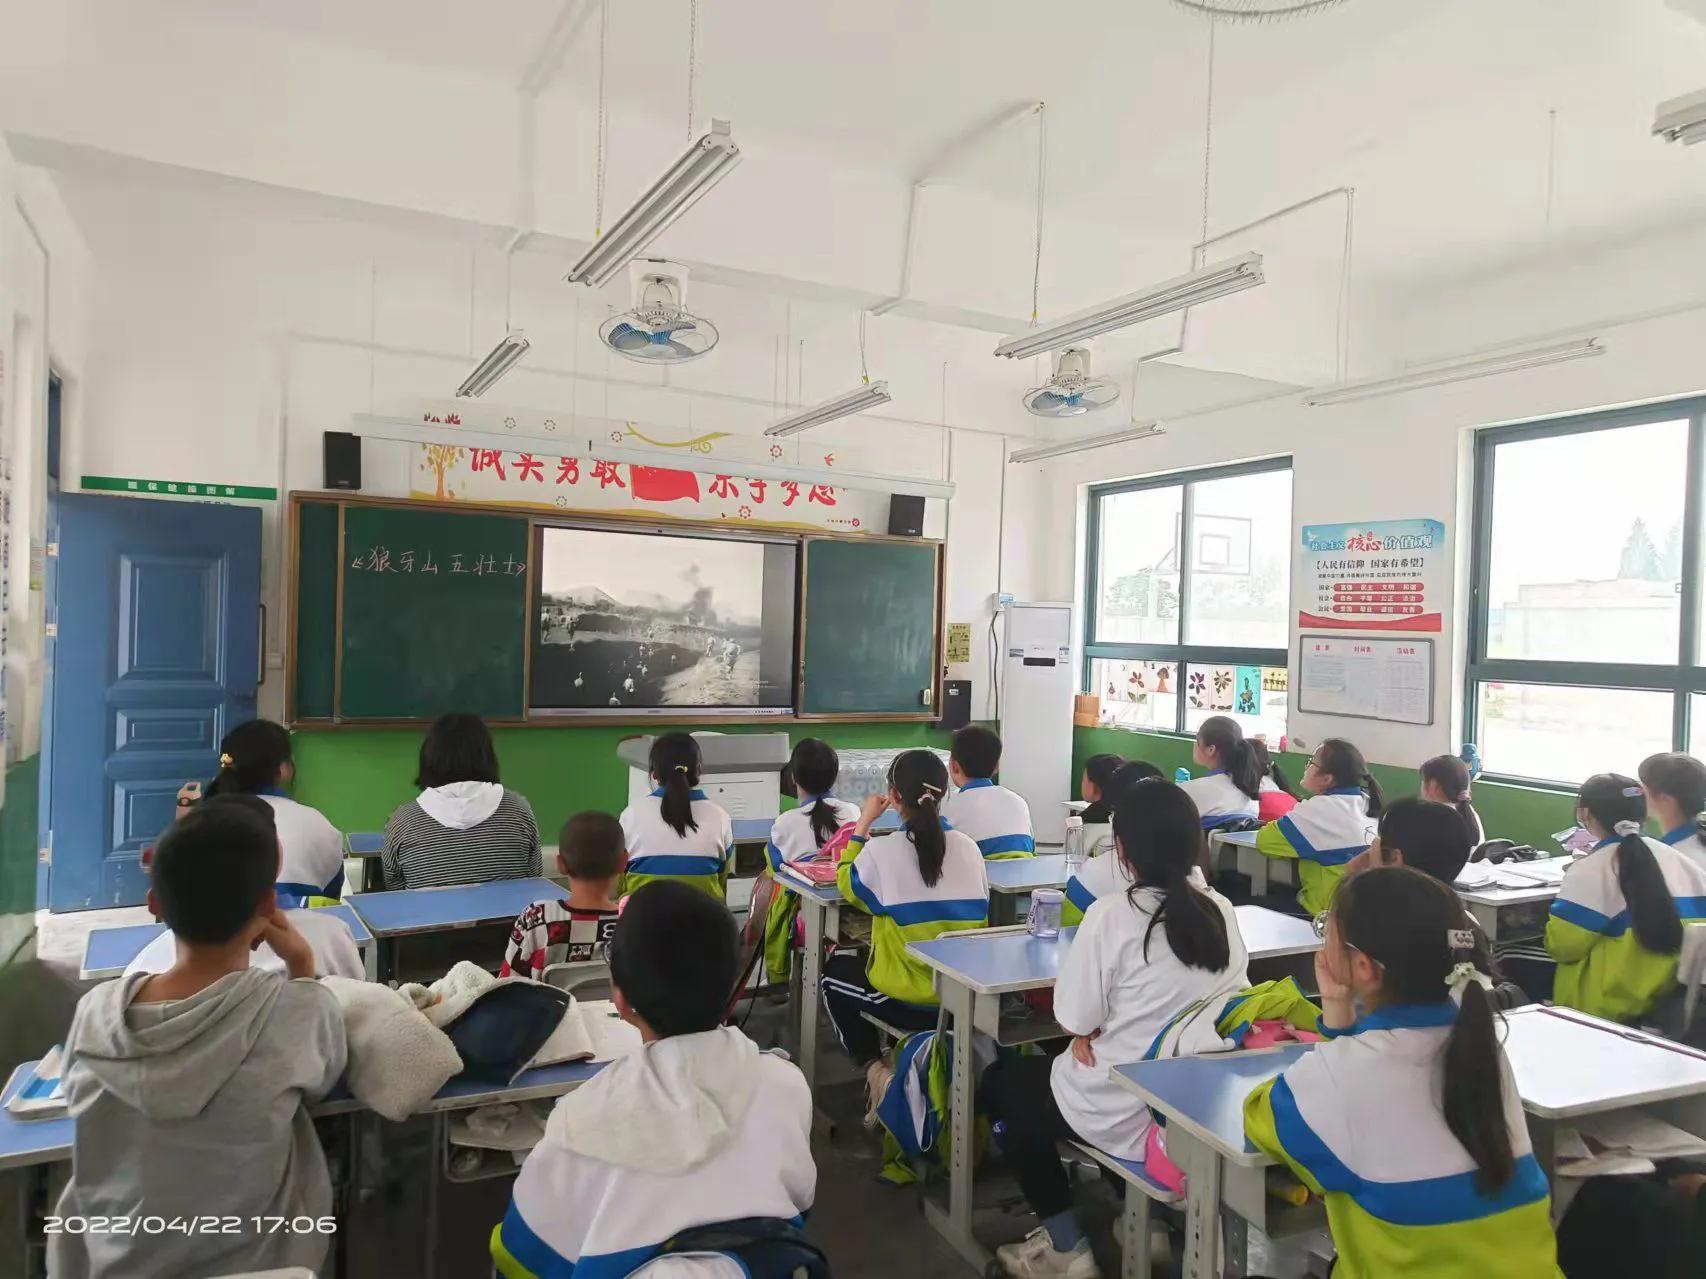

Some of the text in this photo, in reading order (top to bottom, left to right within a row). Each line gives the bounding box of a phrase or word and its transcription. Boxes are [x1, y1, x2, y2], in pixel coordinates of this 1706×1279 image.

[1311, 532, 1433, 552] 社会主义核心价值观
